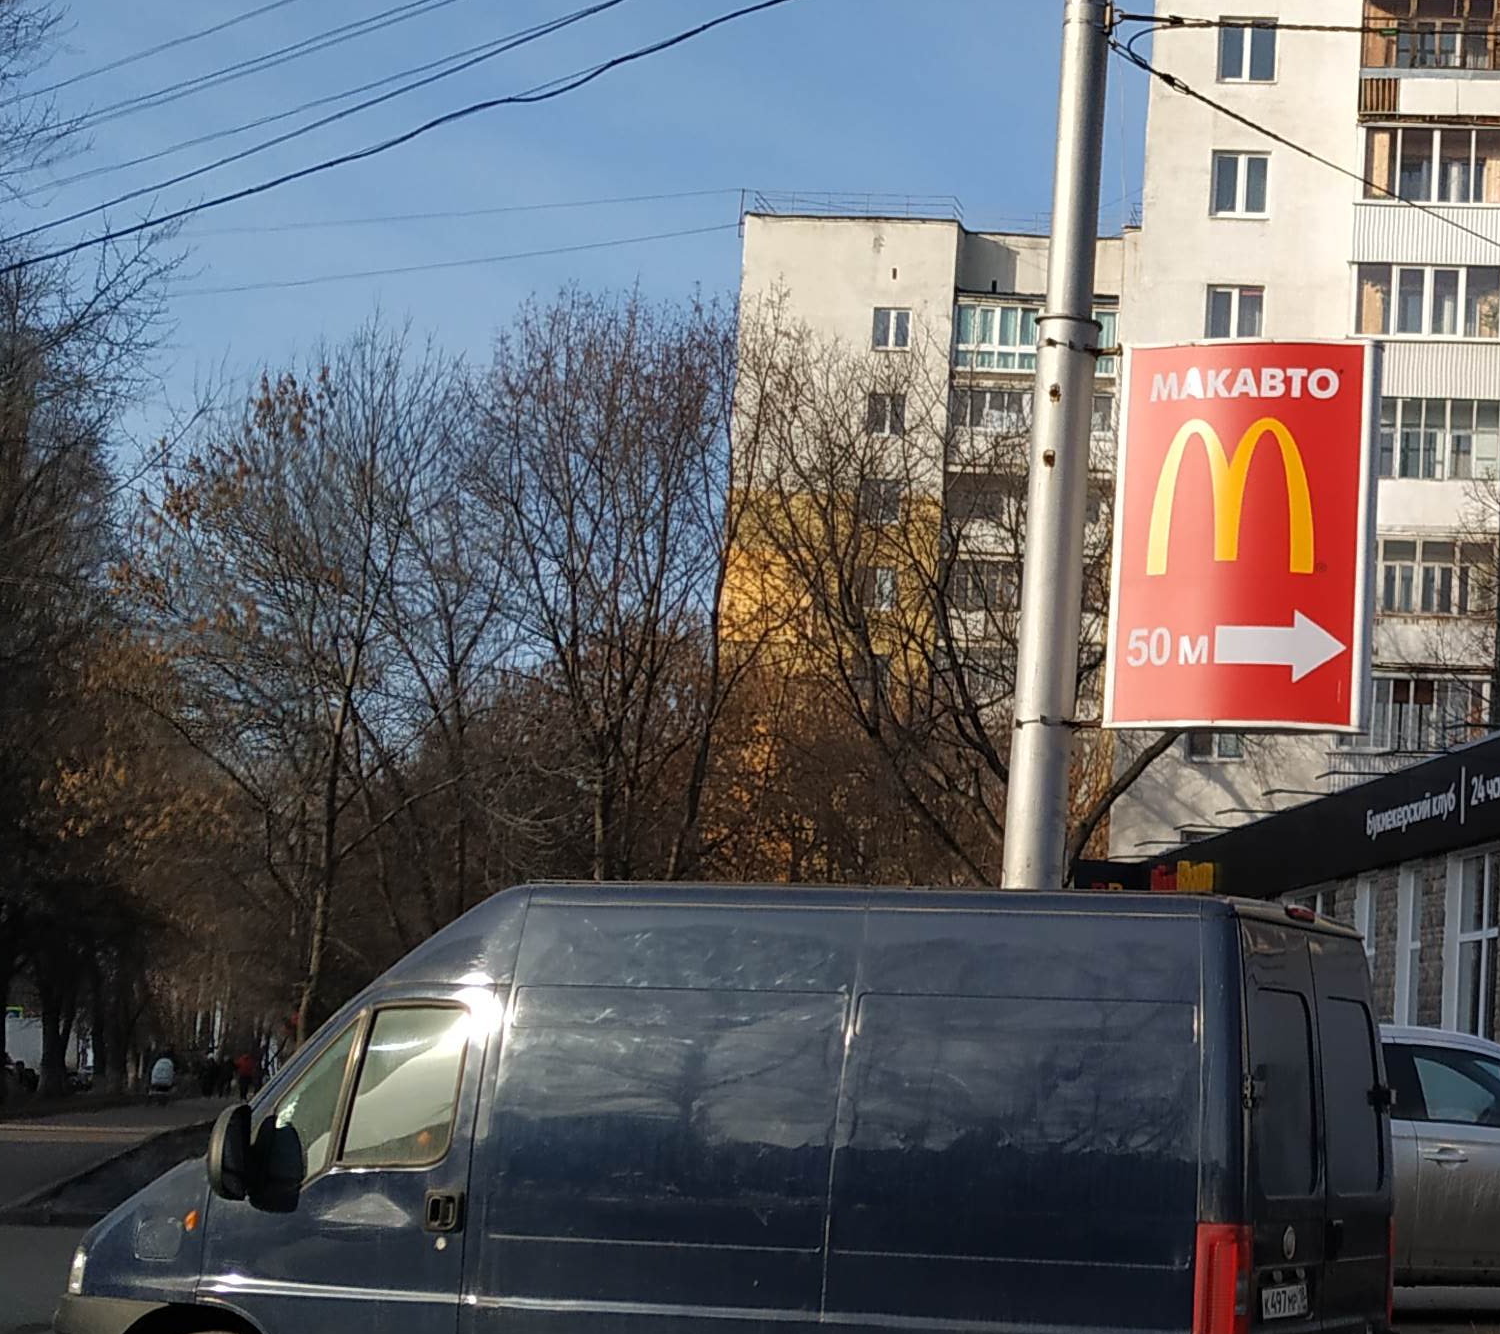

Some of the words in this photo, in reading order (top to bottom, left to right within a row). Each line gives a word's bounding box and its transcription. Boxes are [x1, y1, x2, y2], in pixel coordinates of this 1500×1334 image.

[1150, 366, 1340, 403] МАКАВТО
[1126, 627, 1172, 667] 50
[1432, 781, 1456, 821] клуб
[1470, 774, 1486, 806] 24
